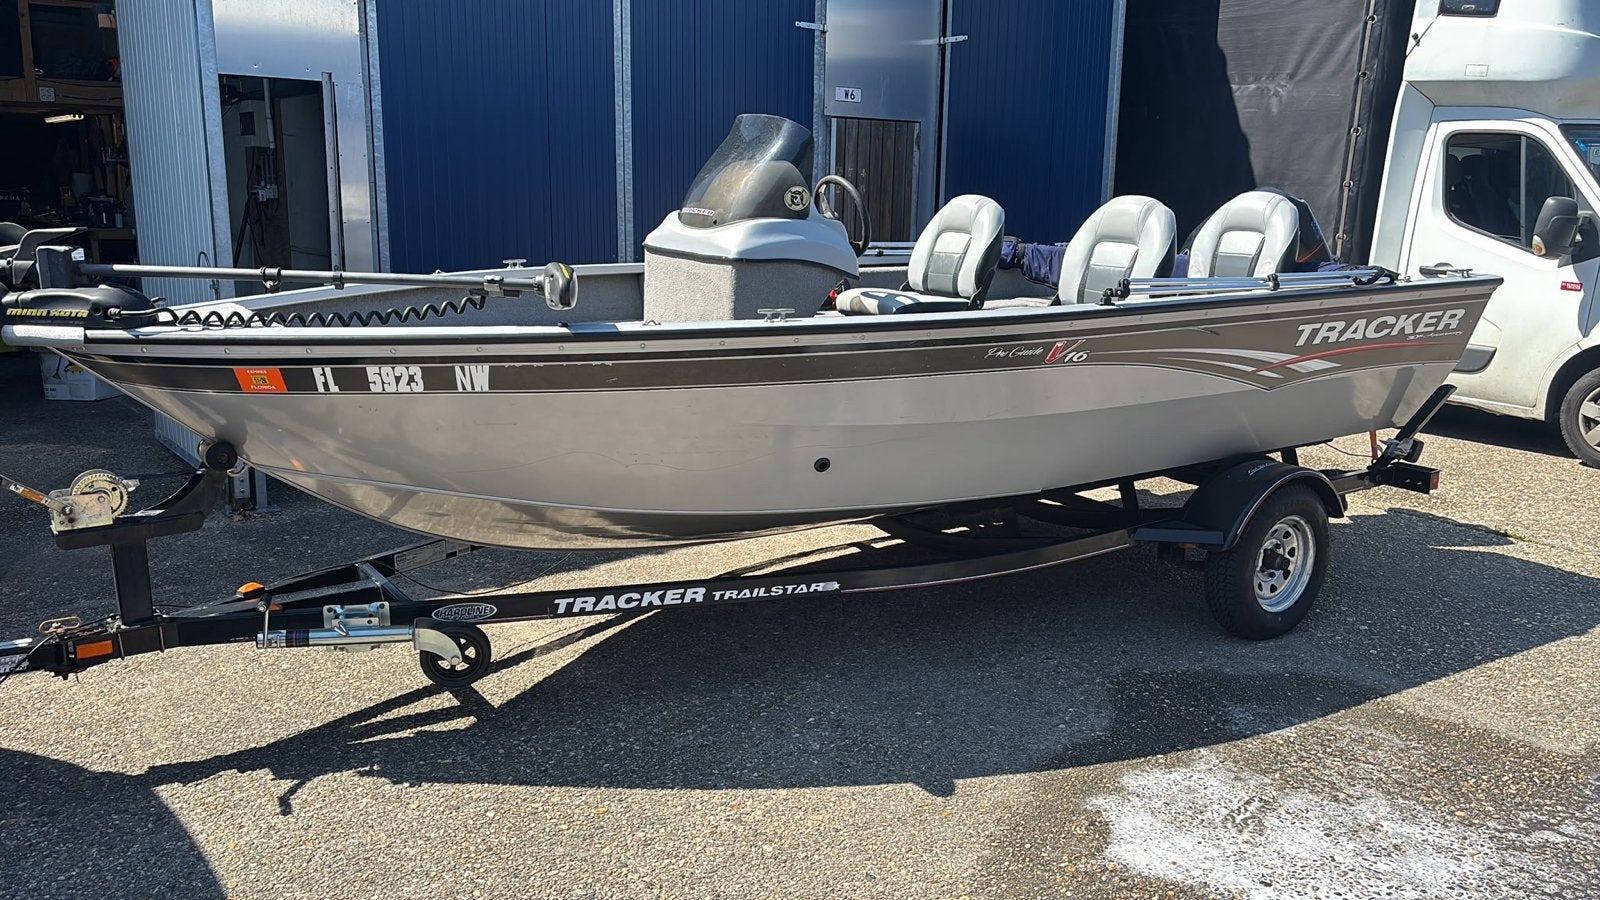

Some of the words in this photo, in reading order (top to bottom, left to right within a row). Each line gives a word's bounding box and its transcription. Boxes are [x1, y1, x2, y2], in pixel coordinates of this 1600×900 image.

[843, 89, 856, 100] W6
[49, 309, 90, 318] KOTA
[1295, 308, 1466, 347] TRACKER
[1008, 346, 1044, 358] Guide
[312, 367, 340, 393] FL
[365, 366, 425, 393] 5923
[454, 365, 490, 392] NW
[554, 587, 706, 614] TRACKER
[712, 583, 824, 600] TRAILSTAR
[438, 606, 490, 618] HARDLINE
